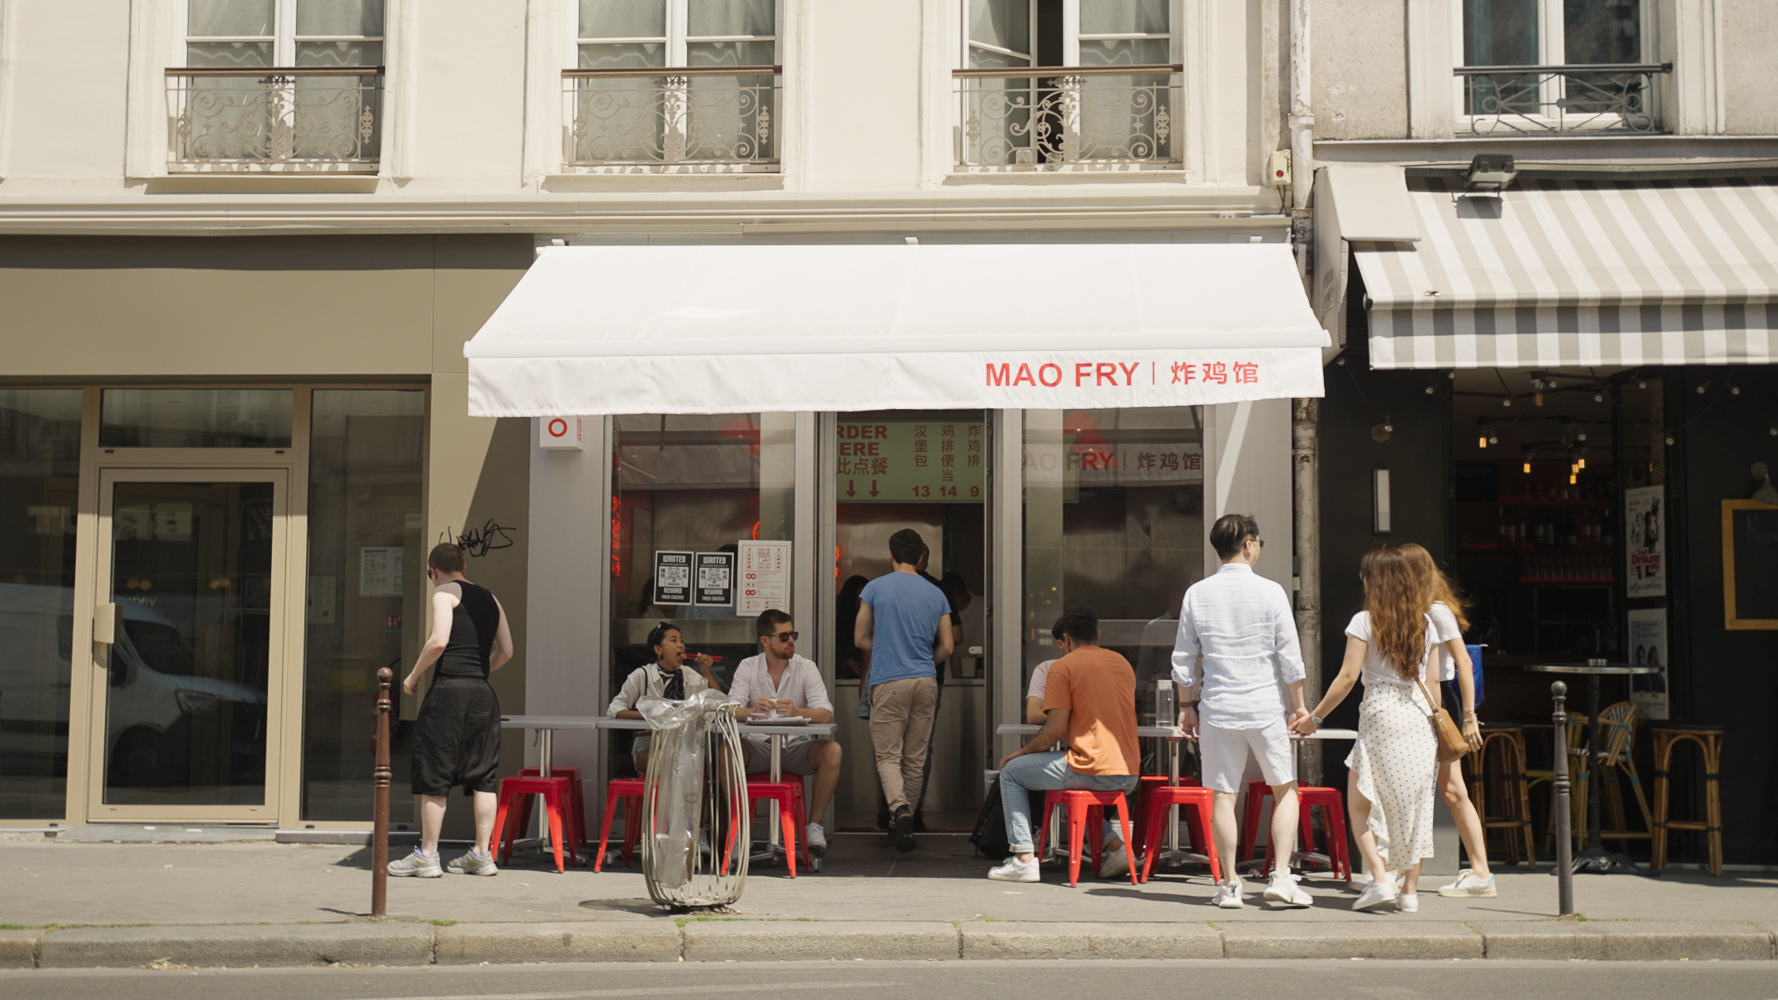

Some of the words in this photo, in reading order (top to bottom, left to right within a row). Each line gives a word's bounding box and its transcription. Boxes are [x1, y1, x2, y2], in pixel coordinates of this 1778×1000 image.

[985, 362, 1063, 388] MAO
[1075, 361, 1140, 388] FRY
[1170, 360, 1259, 386] 炸鸡馆
[837, 424, 888, 439] RDER
[839, 442, 880, 456] ERE
[914, 424, 928, 468] 汉堡包
[940, 424, 955, 483] 鸡排便当
[967, 424, 981, 468] 炸鸡排
[837, 457, 889, 475] 此点餐
[1022, 451, 1058, 471] AO
[1066, 452, 1116, 471] FRY
[1136, 451, 1202, 471] 炸鸡馆
[912, 485, 931, 498] 13
[939, 485, 958, 498] 14
[970, 485, 980, 498] 9
[663, 555, 686, 563] WANTED
[703, 556, 726, 564] WANTED
